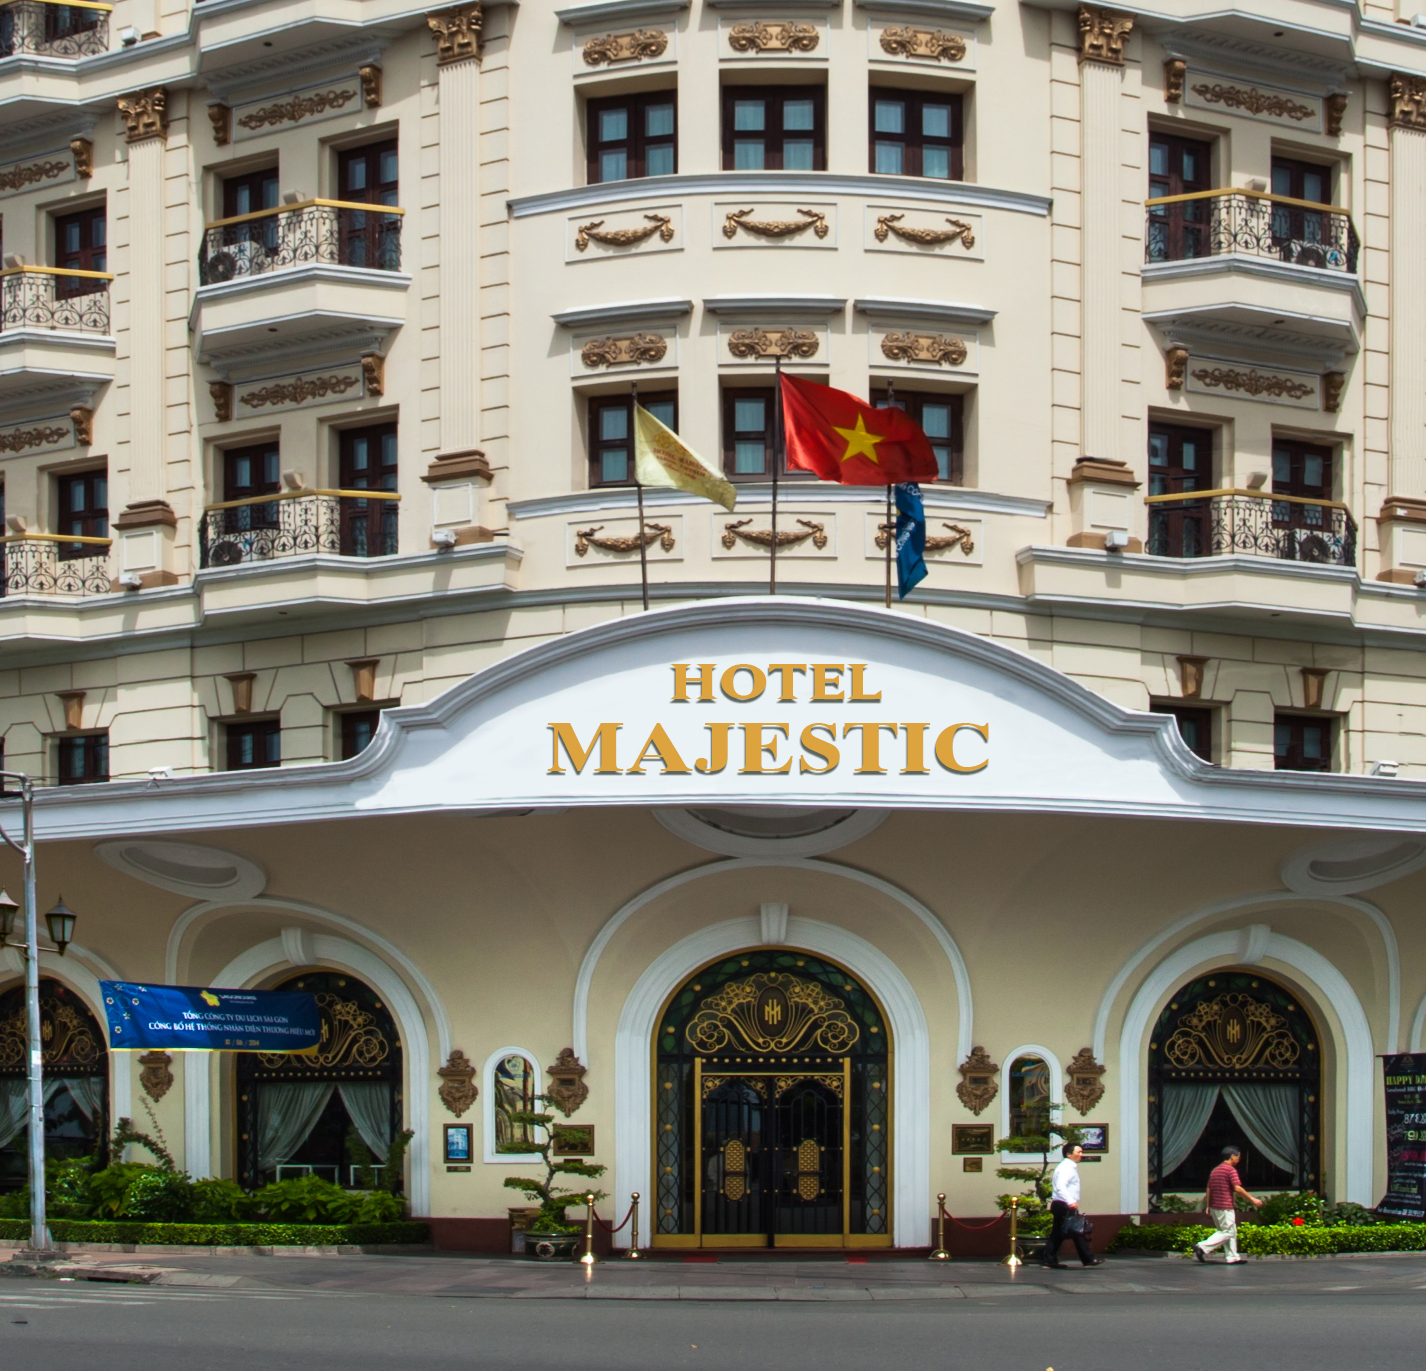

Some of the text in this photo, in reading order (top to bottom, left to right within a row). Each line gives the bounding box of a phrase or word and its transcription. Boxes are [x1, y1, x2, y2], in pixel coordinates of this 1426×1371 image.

[671, 662, 882, 702] HOTEL
[546, 721, 990, 775] MAJESTIC
[235, 1014, 246, 1022] DU
[1386, 1075, 1413, 1085] HAPPY
